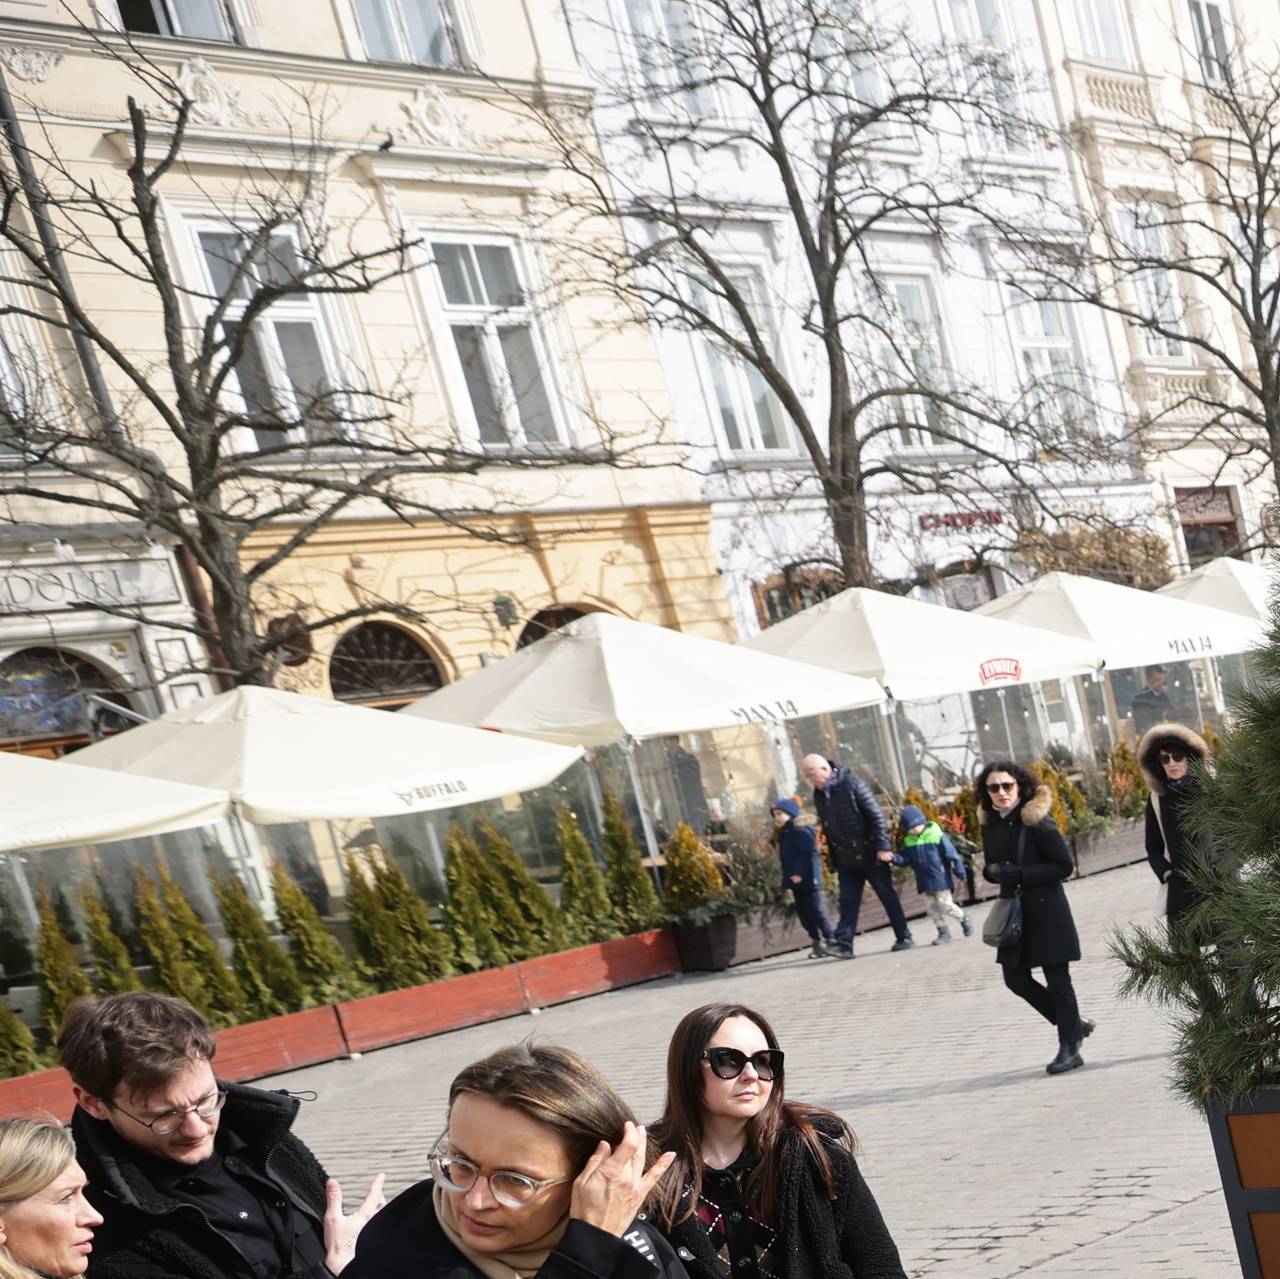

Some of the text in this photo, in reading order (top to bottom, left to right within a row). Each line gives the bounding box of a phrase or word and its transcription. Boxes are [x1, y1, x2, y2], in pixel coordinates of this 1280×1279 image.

[1167, 635, 1212, 655] MAX 14
[730, 700, 799, 723] MAX 14
